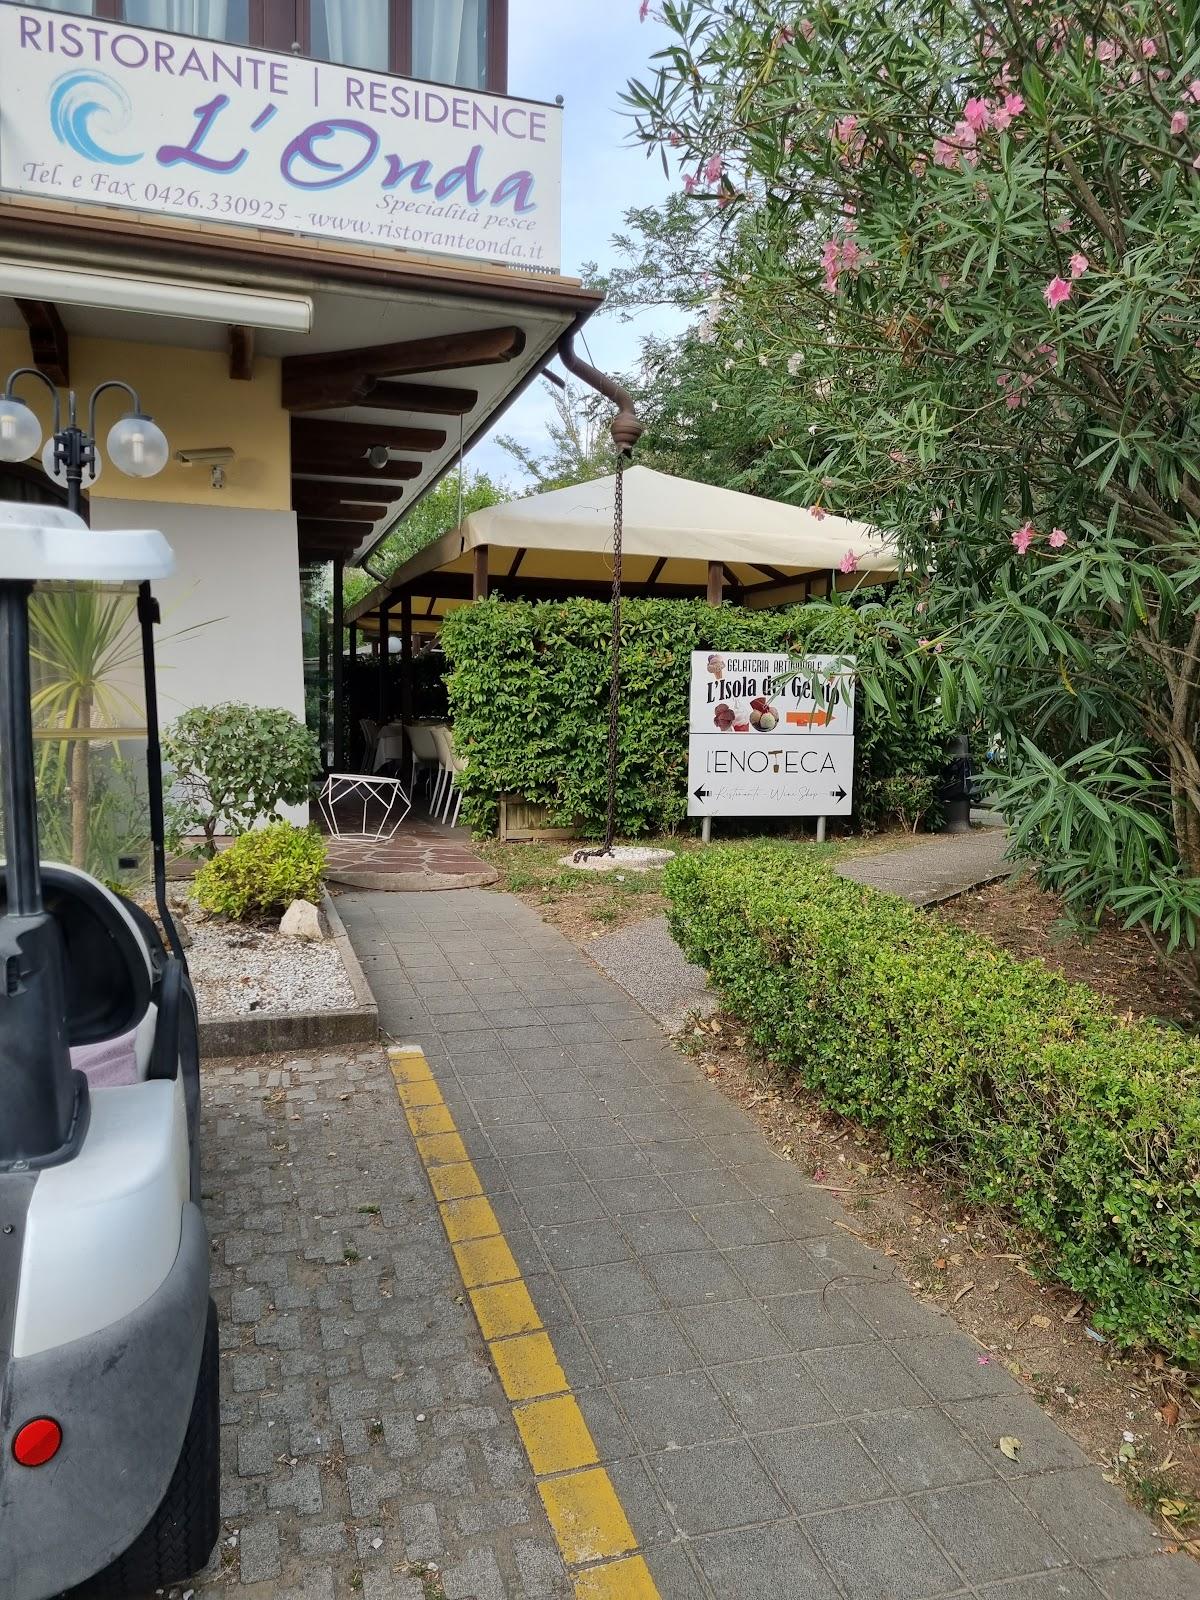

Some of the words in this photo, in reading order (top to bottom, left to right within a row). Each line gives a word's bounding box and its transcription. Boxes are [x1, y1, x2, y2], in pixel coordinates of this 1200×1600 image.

[20, 15, 289, 95] RISTORANTE
[346, 76, 546, 143] RESIDENCE
[156, 93, 537, 215] L'Onda
[23, 162, 64, 187] Tel.
[72, 174, 83, 188] e
[91, 172, 137, 202] Fax
[144, 183, 288, 221] 0426.330925
[308, 211, 544, 260] www.ristoranteonda.it
[376, 194, 480, 223] Specialità
[483, 213, 537, 231] pesce
[706, 676, 757, 703] L'Isola
[727, 658, 769, 673] GELATERIA
